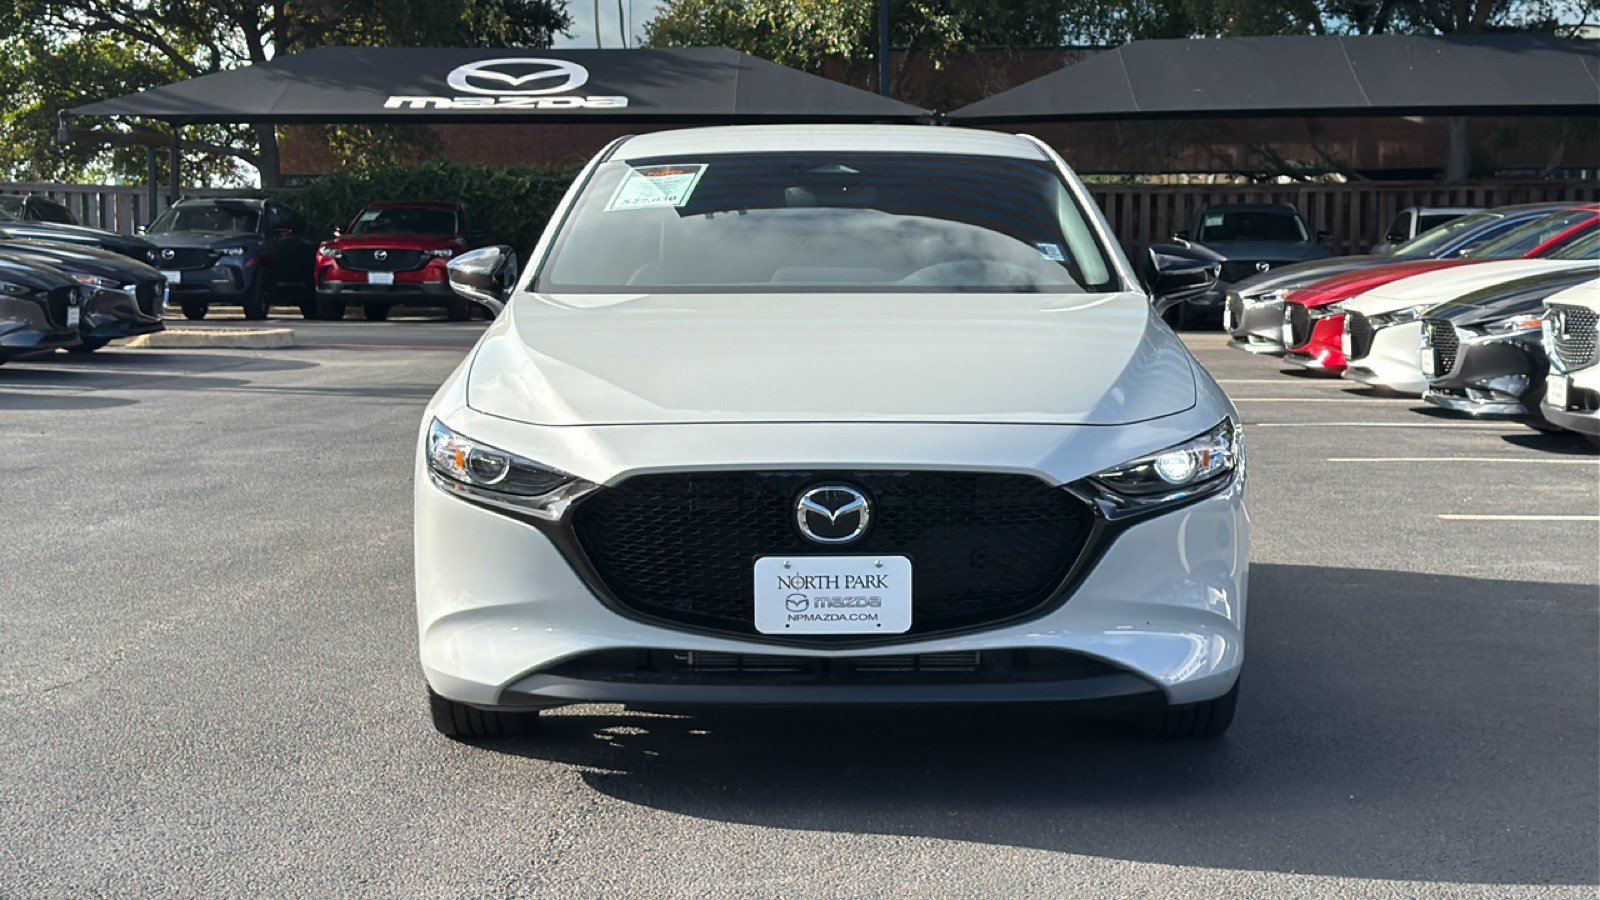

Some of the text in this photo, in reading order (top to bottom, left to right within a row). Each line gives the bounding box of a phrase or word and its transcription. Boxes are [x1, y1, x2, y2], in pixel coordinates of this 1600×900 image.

[384, 95, 629, 110] mazda
[777, 574, 889, 590] NORTH PARK
[813, 595, 882, 608] mazda
[787, 613, 879, 622] NPMAZDA.COM
